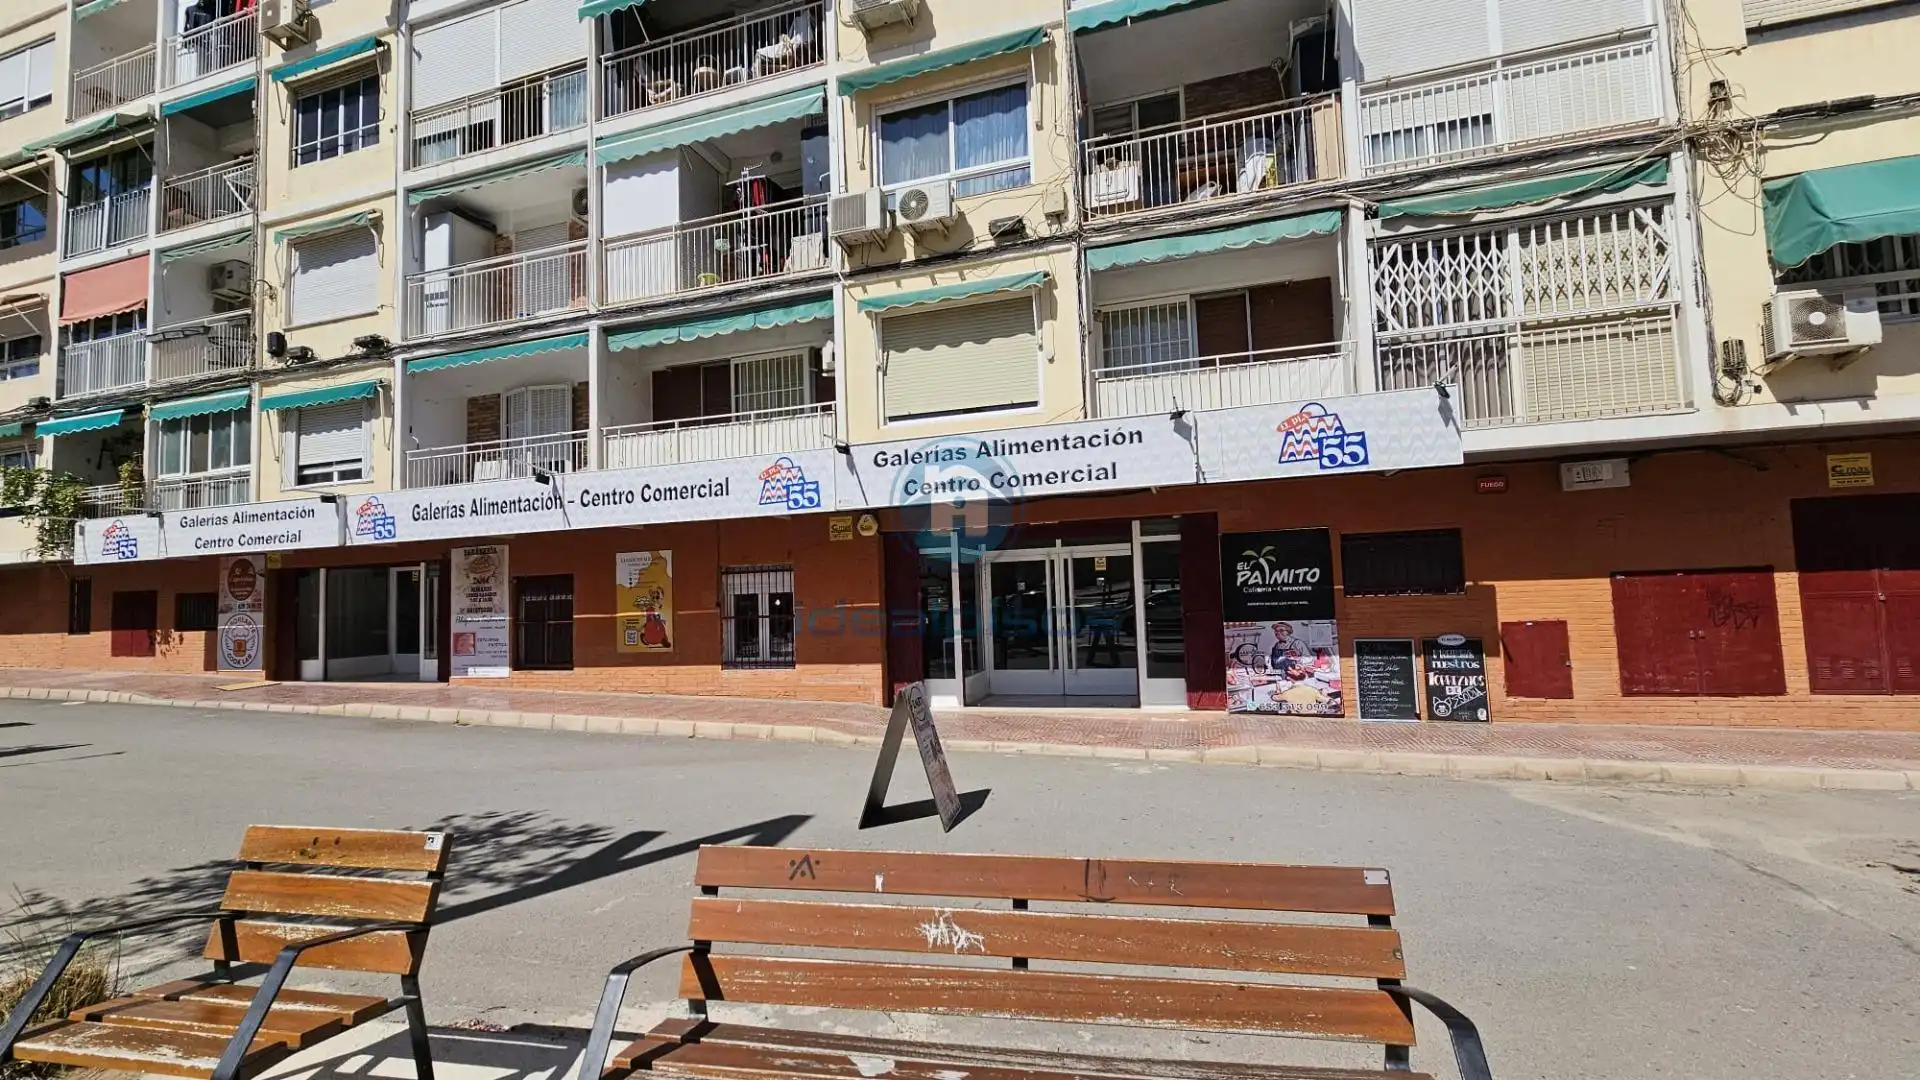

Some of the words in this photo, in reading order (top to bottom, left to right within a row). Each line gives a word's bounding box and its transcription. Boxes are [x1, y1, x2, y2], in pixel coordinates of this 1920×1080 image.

[873, 444, 968, 469] Galerías
[975, 426, 1144, 459] Alimentación
[1320, 431, 1366, 468] 55
[903, 470, 981, 497] Centro
[989, 462, 1118, 490] Comercial
[411, 500, 466, 522] Galerías
[469, 491, 563, 518] Alimentación
[579, 485, 635, 508] Centro
[640, 476, 730, 504] Comercial
[788, 482, 819, 509] 55
[179, 513, 229, 529] Galerías
[231, 506, 316, 526] Alimentación
[375, 517, 395, 540] 55
[119, 540, 137, 558] 55
[194, 533, 234, 550] Centro
[237, 530, 302, 547] Comercial
[1236, 561, 1251, 571] EL
[1432, 659, 1480, 669] nuestros
